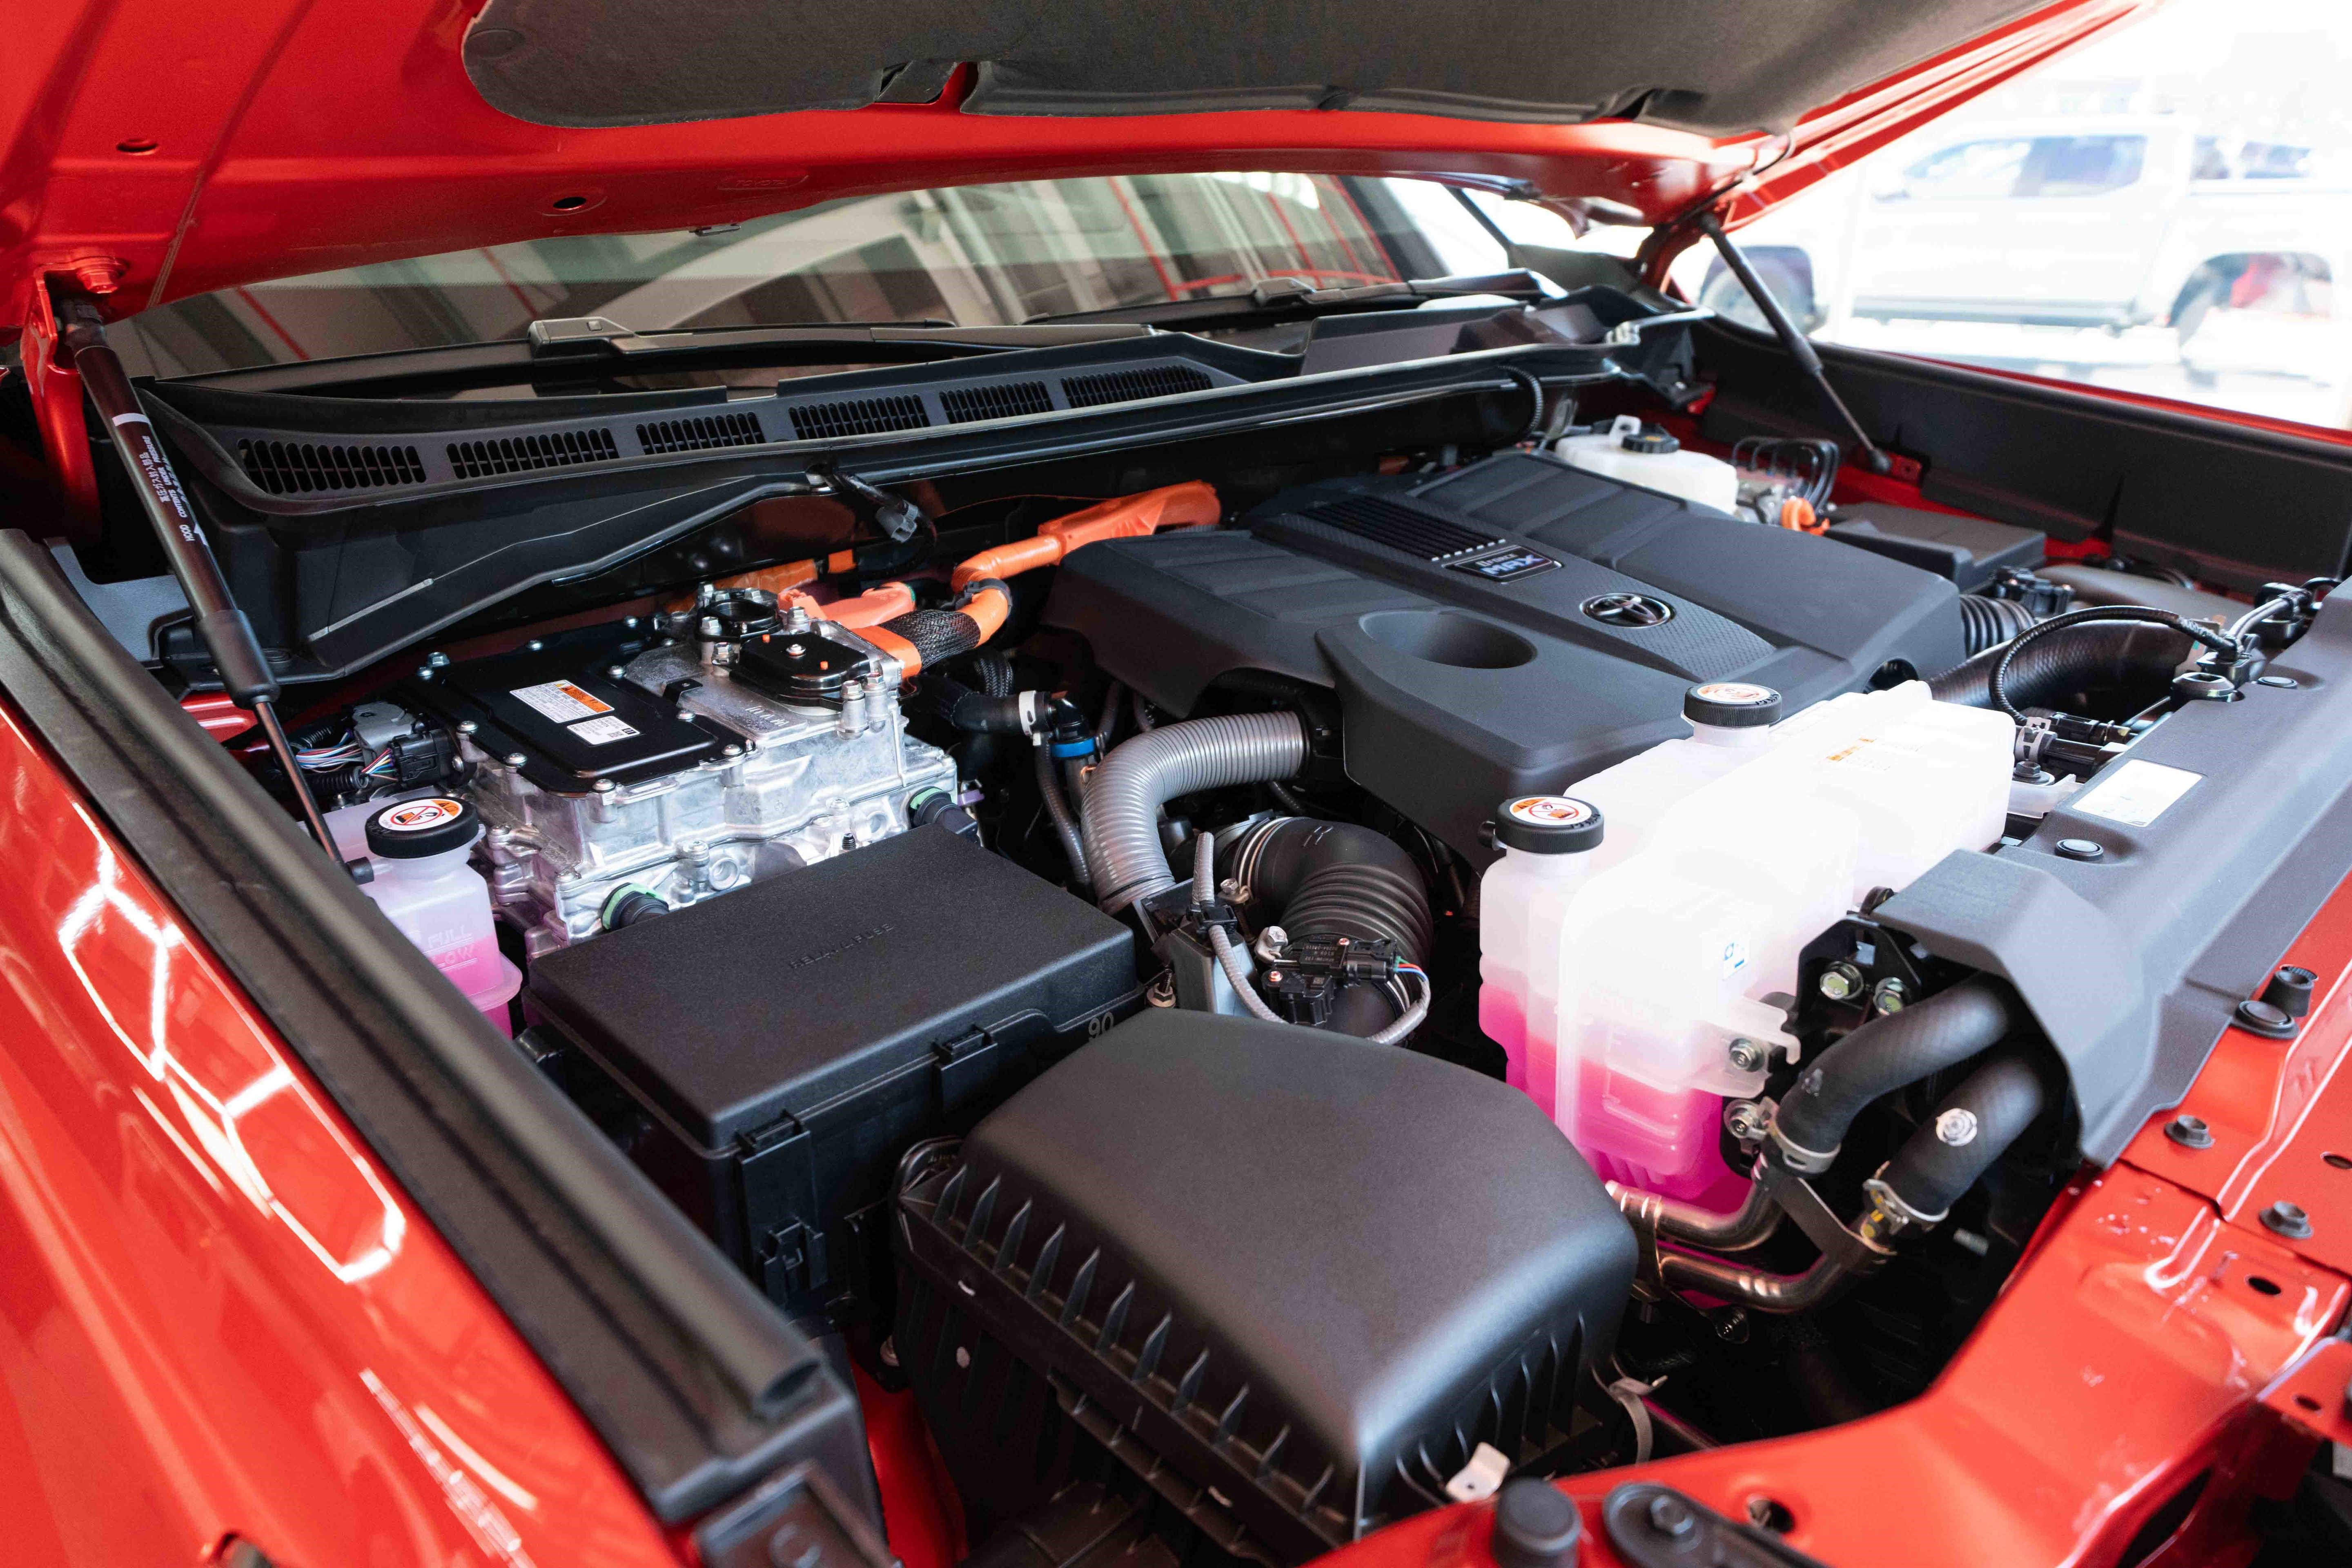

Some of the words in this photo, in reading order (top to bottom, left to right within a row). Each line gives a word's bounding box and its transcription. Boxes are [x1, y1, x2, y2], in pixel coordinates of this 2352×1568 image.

[142, 435, 161, 463] PRESSURE
[158, 467, 172, 485] UNDER
[168, 489, 188, 518] CONTENTS
[179, 524, 196, 541] HOOD
[1480, 554, 1545, 575] MAX
[428, 925, 472, 949] FULL
